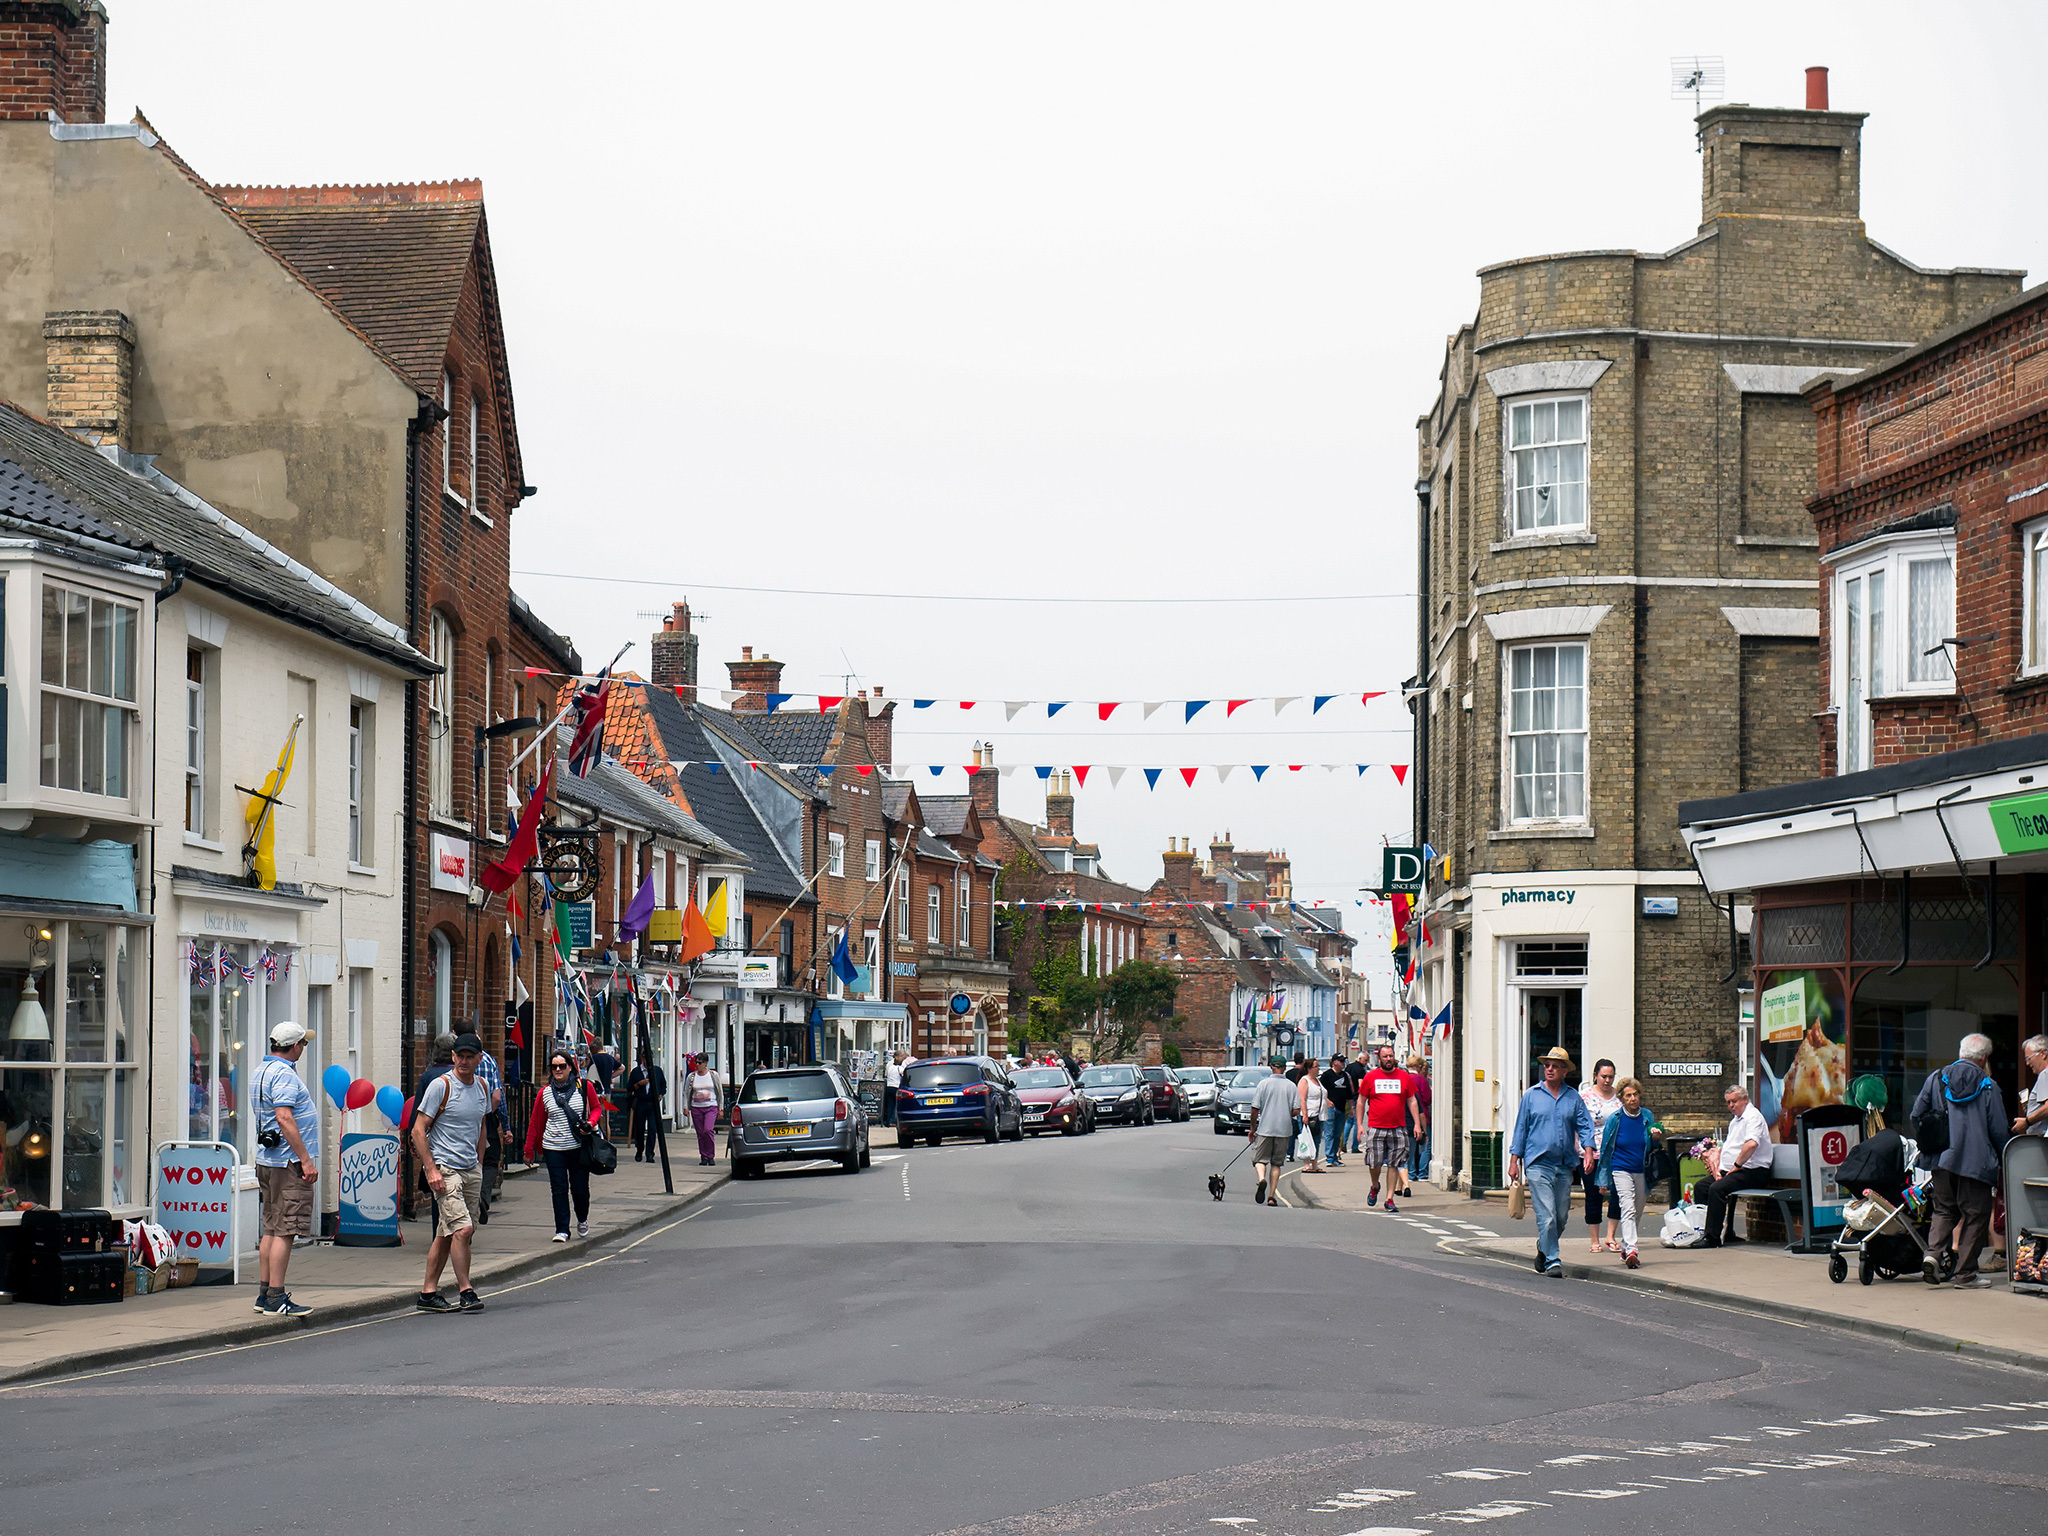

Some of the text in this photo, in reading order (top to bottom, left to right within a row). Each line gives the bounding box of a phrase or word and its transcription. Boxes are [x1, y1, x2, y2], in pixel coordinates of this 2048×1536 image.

[2009, 812, 2034, 838] The
[1391, 853, 1421, 882] D
[1502, 888, 1575, 906] pharmacy
[204, 910, 224, 930] Oscar
[233, 913, 248, 933] Rose
[1764, 992, 1799, 1008] Inspiring ideas
[1653, 1064, 1719, 1074] CHURCH ST
[772, 1127, 790, 1136] AX57
[1827, 1138, 1842, 1154] £1
[342, 1142, 398, 1172] We are
[162, 1166, 229, 1185] WOW
[341, 1158, 398, 1204] open
[162, 1201, 228, 1212] VINTAGE
[166, 1229, 228, 1249] WOW
